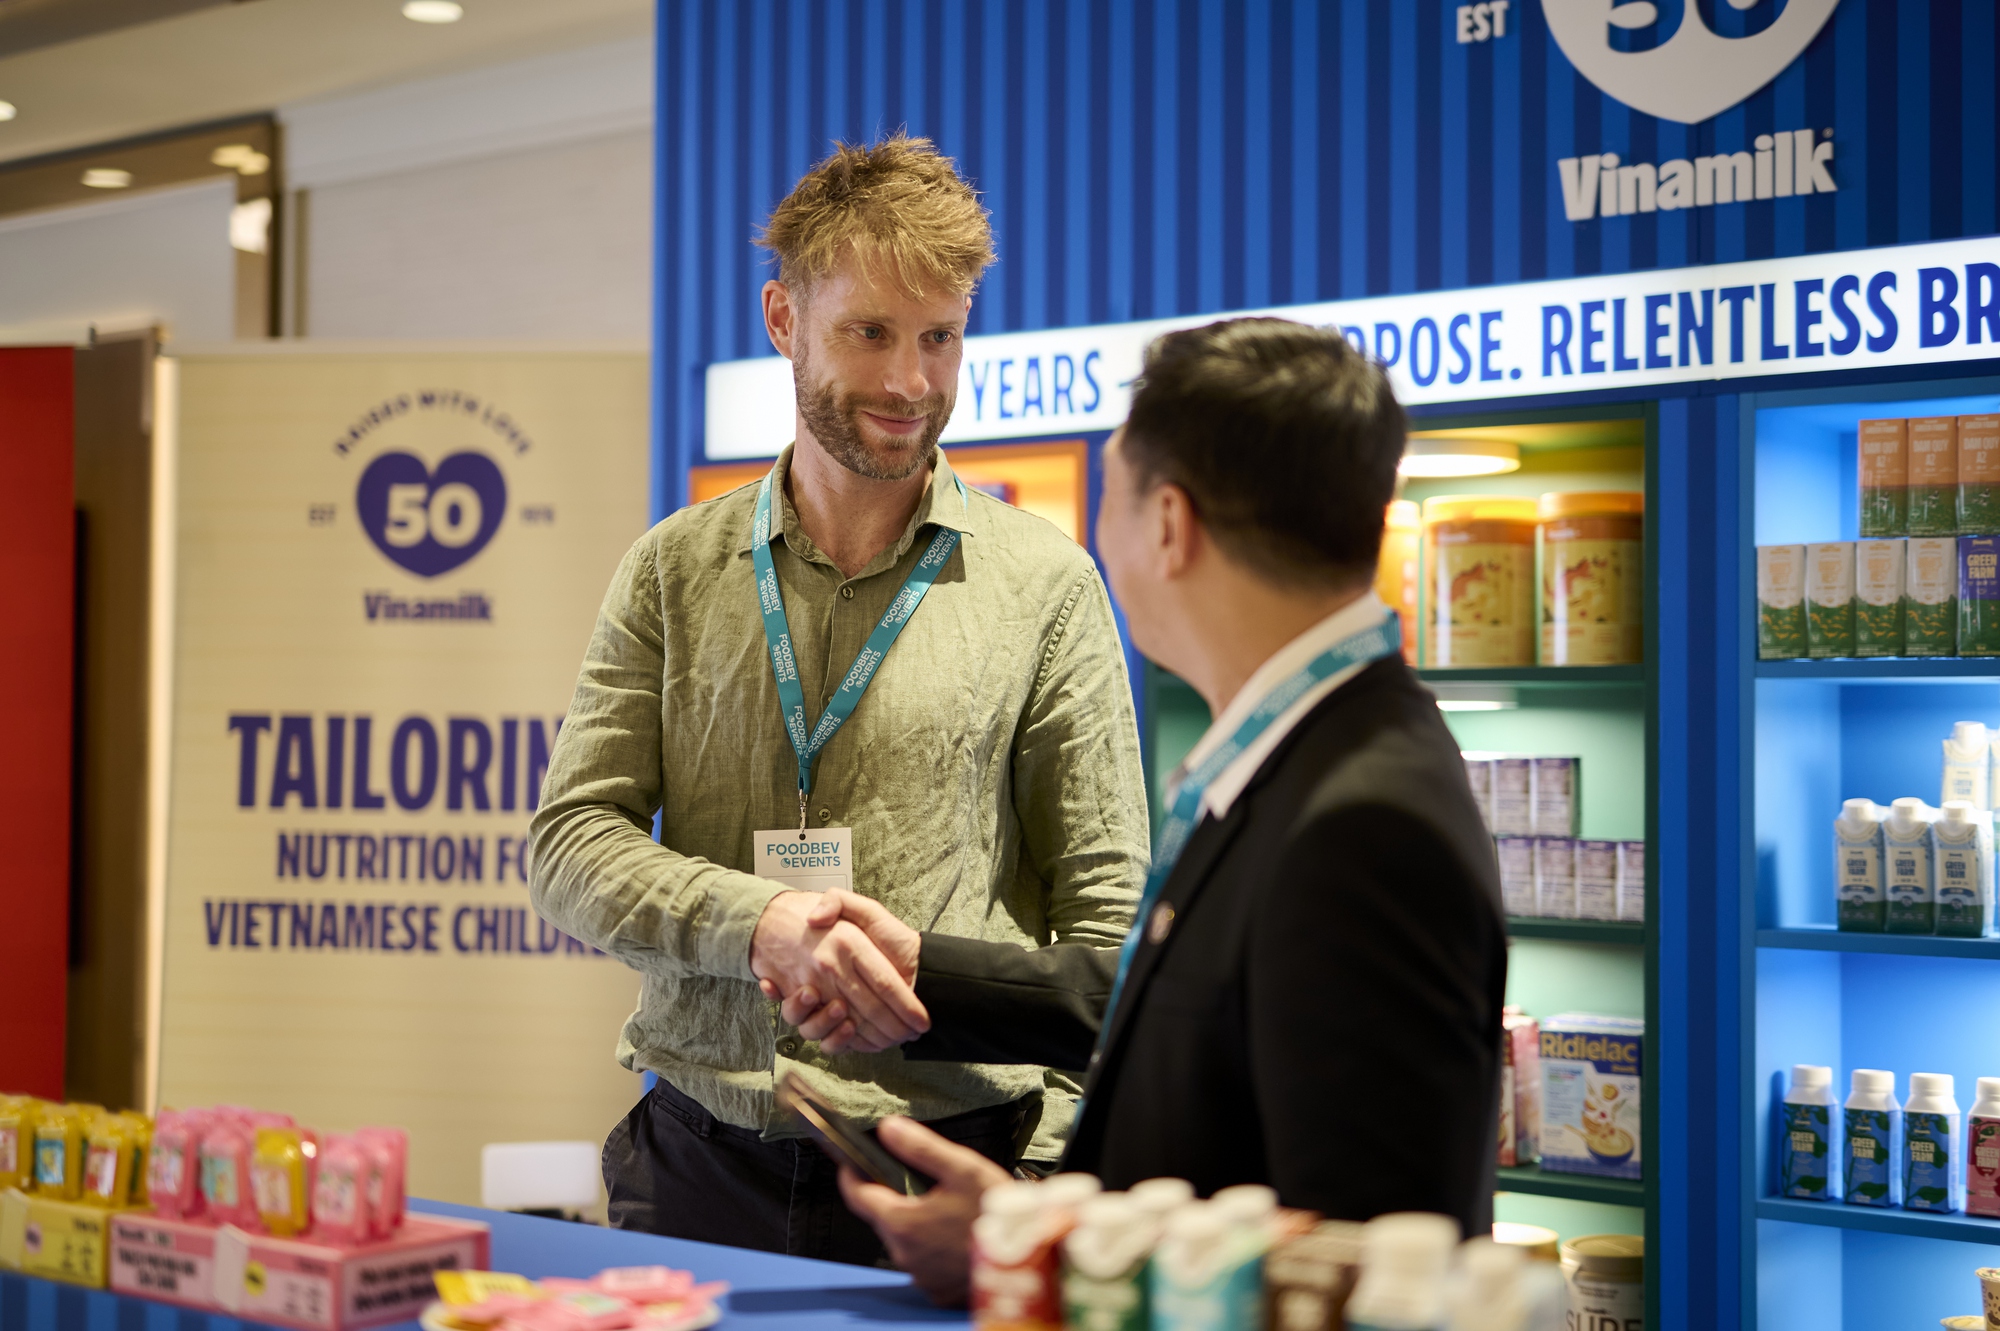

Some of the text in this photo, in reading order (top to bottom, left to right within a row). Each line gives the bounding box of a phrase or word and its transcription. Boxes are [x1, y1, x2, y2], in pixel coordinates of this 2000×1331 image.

[1457, 2, 1508, 43] EST
[1542, 271, 1898, 377] RELENTLESS
[969, 350, 1101, 421] YEARS
[384, 483, 483, 548] 50
[760, 508, 769, 546] FOODBEV
[920, 527, 949, 569] FOODBEV
[938, 534, 956, 562] EVENTS
[1967, 554, 1997, 566] GREEN
[765, 567, 781, 611] FOODBEV
[1969, 567, 1996, 579] FARM
[365, 590, 492, 623] Vinamilk
[760, 585, 773, 615] EVENTS
[881, 586, 911, 628] FOODBEV
[899, 590, 920, 619] EVENTS
[773, 650, 787, 683] EVENTS
[779, 633, 797, 681] FOODBEV
[842, 646, 873, 693] FOODBEV
[860, 651, 881, 682] EVENTS
[794, 705, 807, 750] FOODBE
[805, 712, 834, 759] FOODBEV
[817, 717, 841, 746] EVENTS
[277, 834, 484, 881] NUTRITION
[767, 842, 840, 855] FOODBEV
[792, 856, 841, 868] EVENTS
[204, 902, 440, 950] VIETNAMESE
